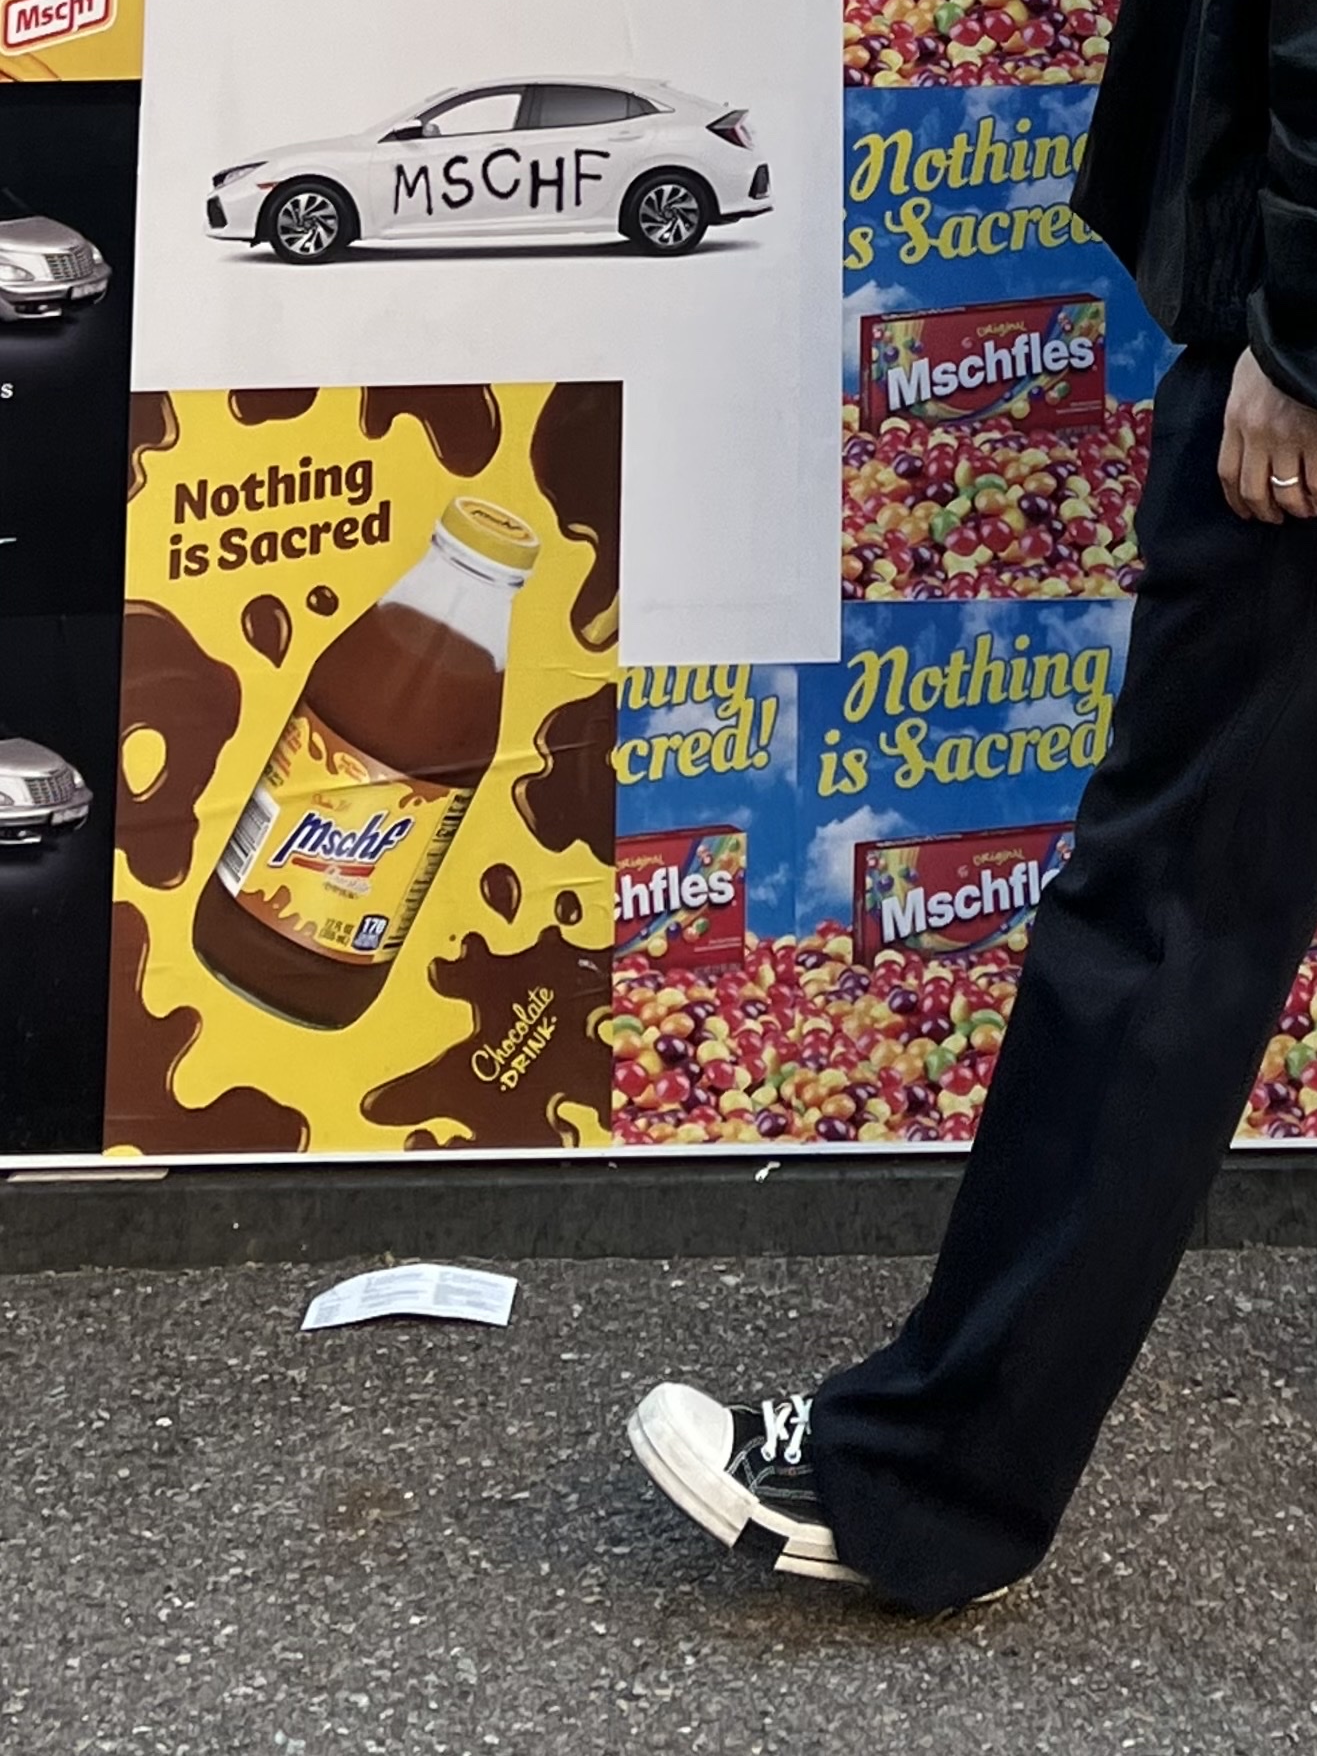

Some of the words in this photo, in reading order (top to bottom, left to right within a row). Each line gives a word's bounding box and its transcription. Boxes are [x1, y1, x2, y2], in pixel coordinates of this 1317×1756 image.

[394, 148, 610, 216] MSCHF
[885, 196, 1103, 264] Sacre
[887, 331, 1095, 412] Mschfles
[174, 455, 373, 524] Nothing
[169, 534, 209, 580] is
[217, 500, 391, 571] Sacred
[843, 634, 1112, 723] Nothing
[611, 697, 778, 785] cred!
[818, 729, 868, 797] is
[879, 694, 1114, 788] Sacred
[614, 865, 735, 921] hfles
[882, 860, 1060, 944] Mschfl
[471, 986, 554, 1081] Chocolate
